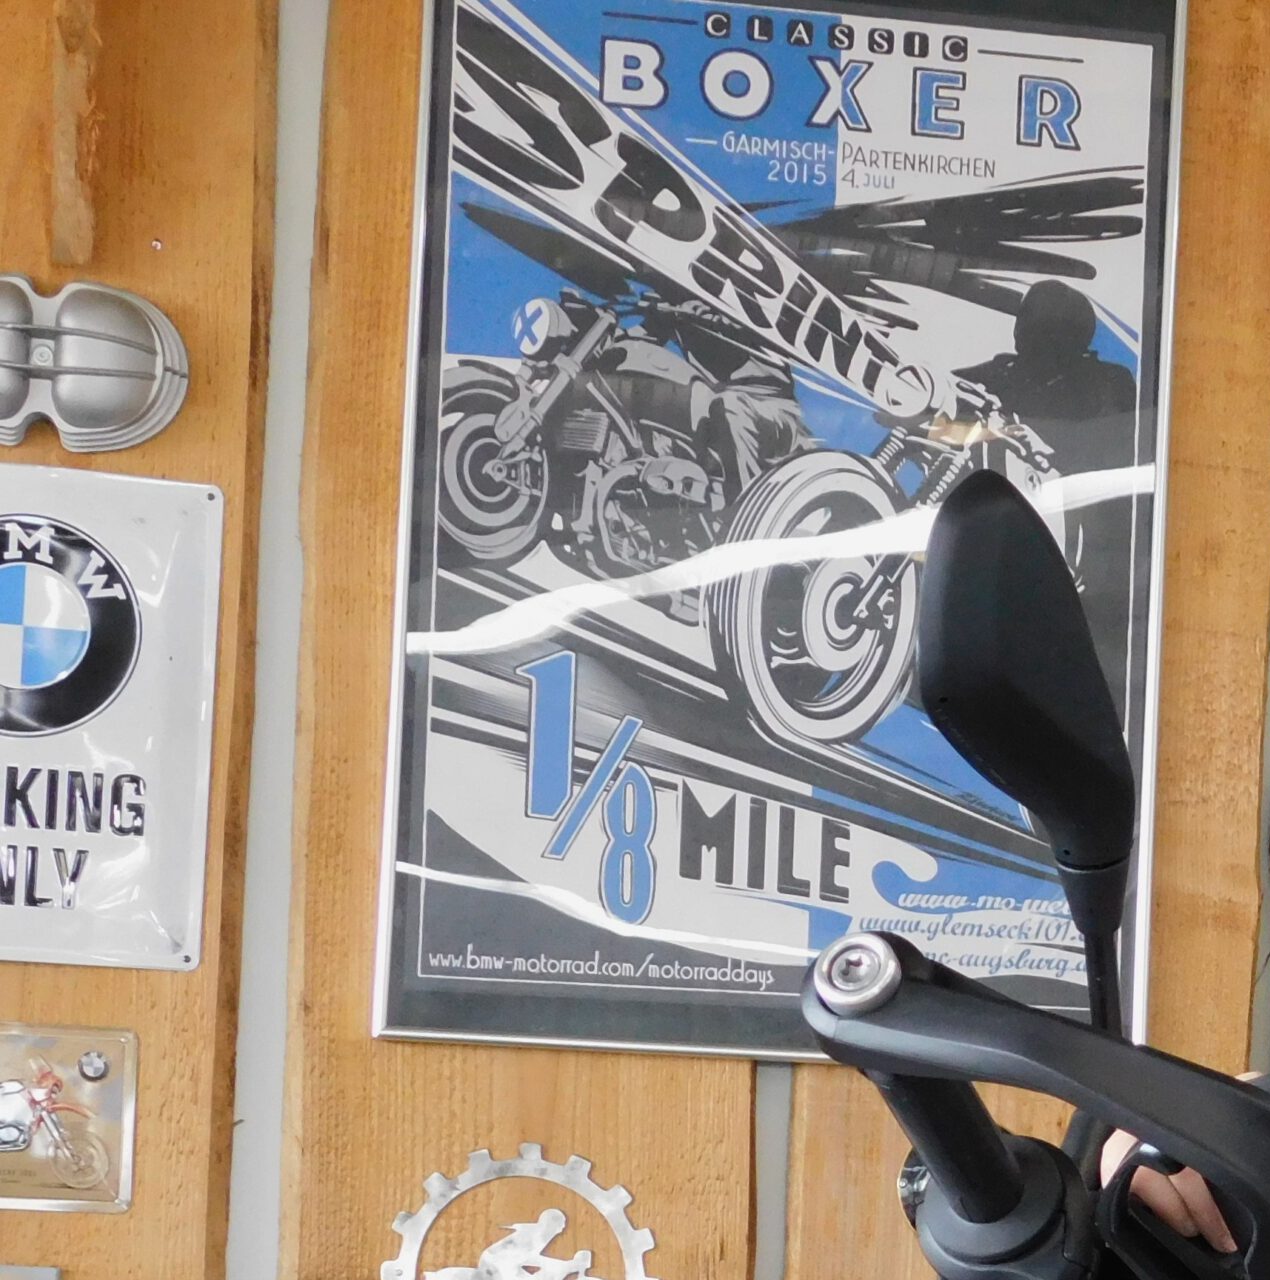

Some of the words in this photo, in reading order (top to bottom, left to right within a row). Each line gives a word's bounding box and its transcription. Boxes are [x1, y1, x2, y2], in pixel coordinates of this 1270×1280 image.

[705, 11, 969, 61] CLASSIC
[601, 36, 1081, 151] BOXER
[767, 160, 828, 186] 2015
[841, 168, 859, 190] 4.
[862, 174, 896, 190] JULI
[841, 142, 997, 178] PARTENKIRCHEN
[514, 649, 658, 926] 1/8
[678, 779, 851, 904] MILE
[428, 943, 775, 991] www.bmw-motorrad.com/motorraddays
